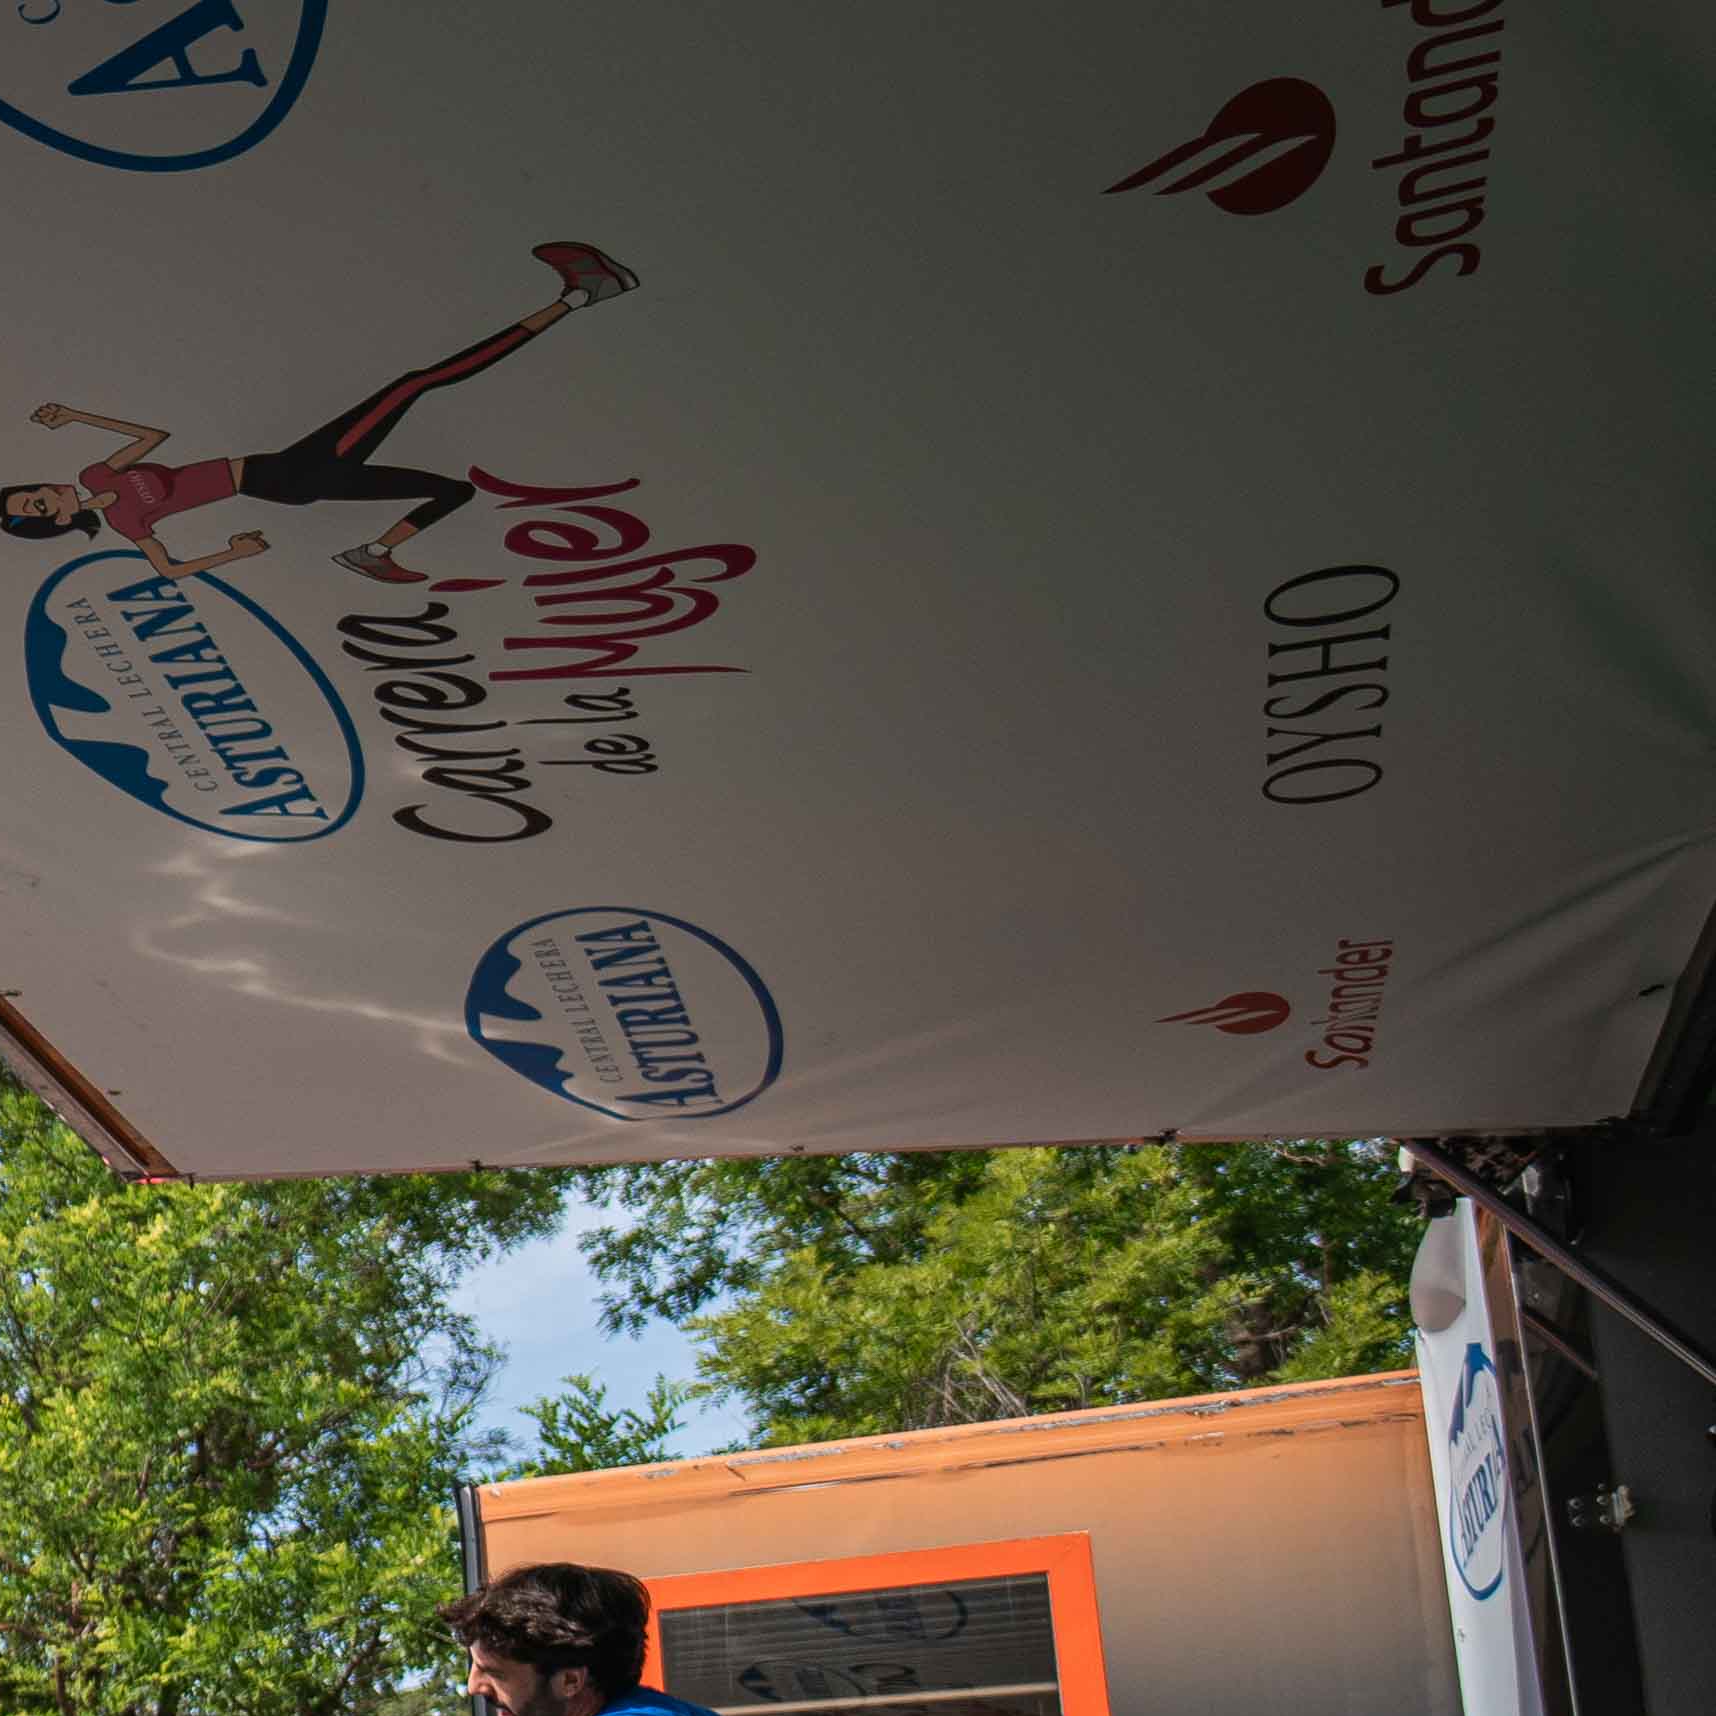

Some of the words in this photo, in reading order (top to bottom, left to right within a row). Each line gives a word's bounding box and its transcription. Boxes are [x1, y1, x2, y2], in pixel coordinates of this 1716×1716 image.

[428, 464, 758, 682] Mujer
[67, 597, 152, 700] LECHERA
[106, 575, 329, 820] ASTURIANA
[512, 687, 640, 726] la
[1262, 565, 1400, 804] OYSHO
[141, 705, 219, 793] CENTRAL
[336, 601, 553, 844] Carrera
[537, 733, 659, 775] de
[529, 937, 590, 1015] LECHERA
[574, 919, 726, 1107] ASTURIANA
[1304, 938, 1394, 1070] Santander
[571, 1018, 624, 1084] CENTRAL
